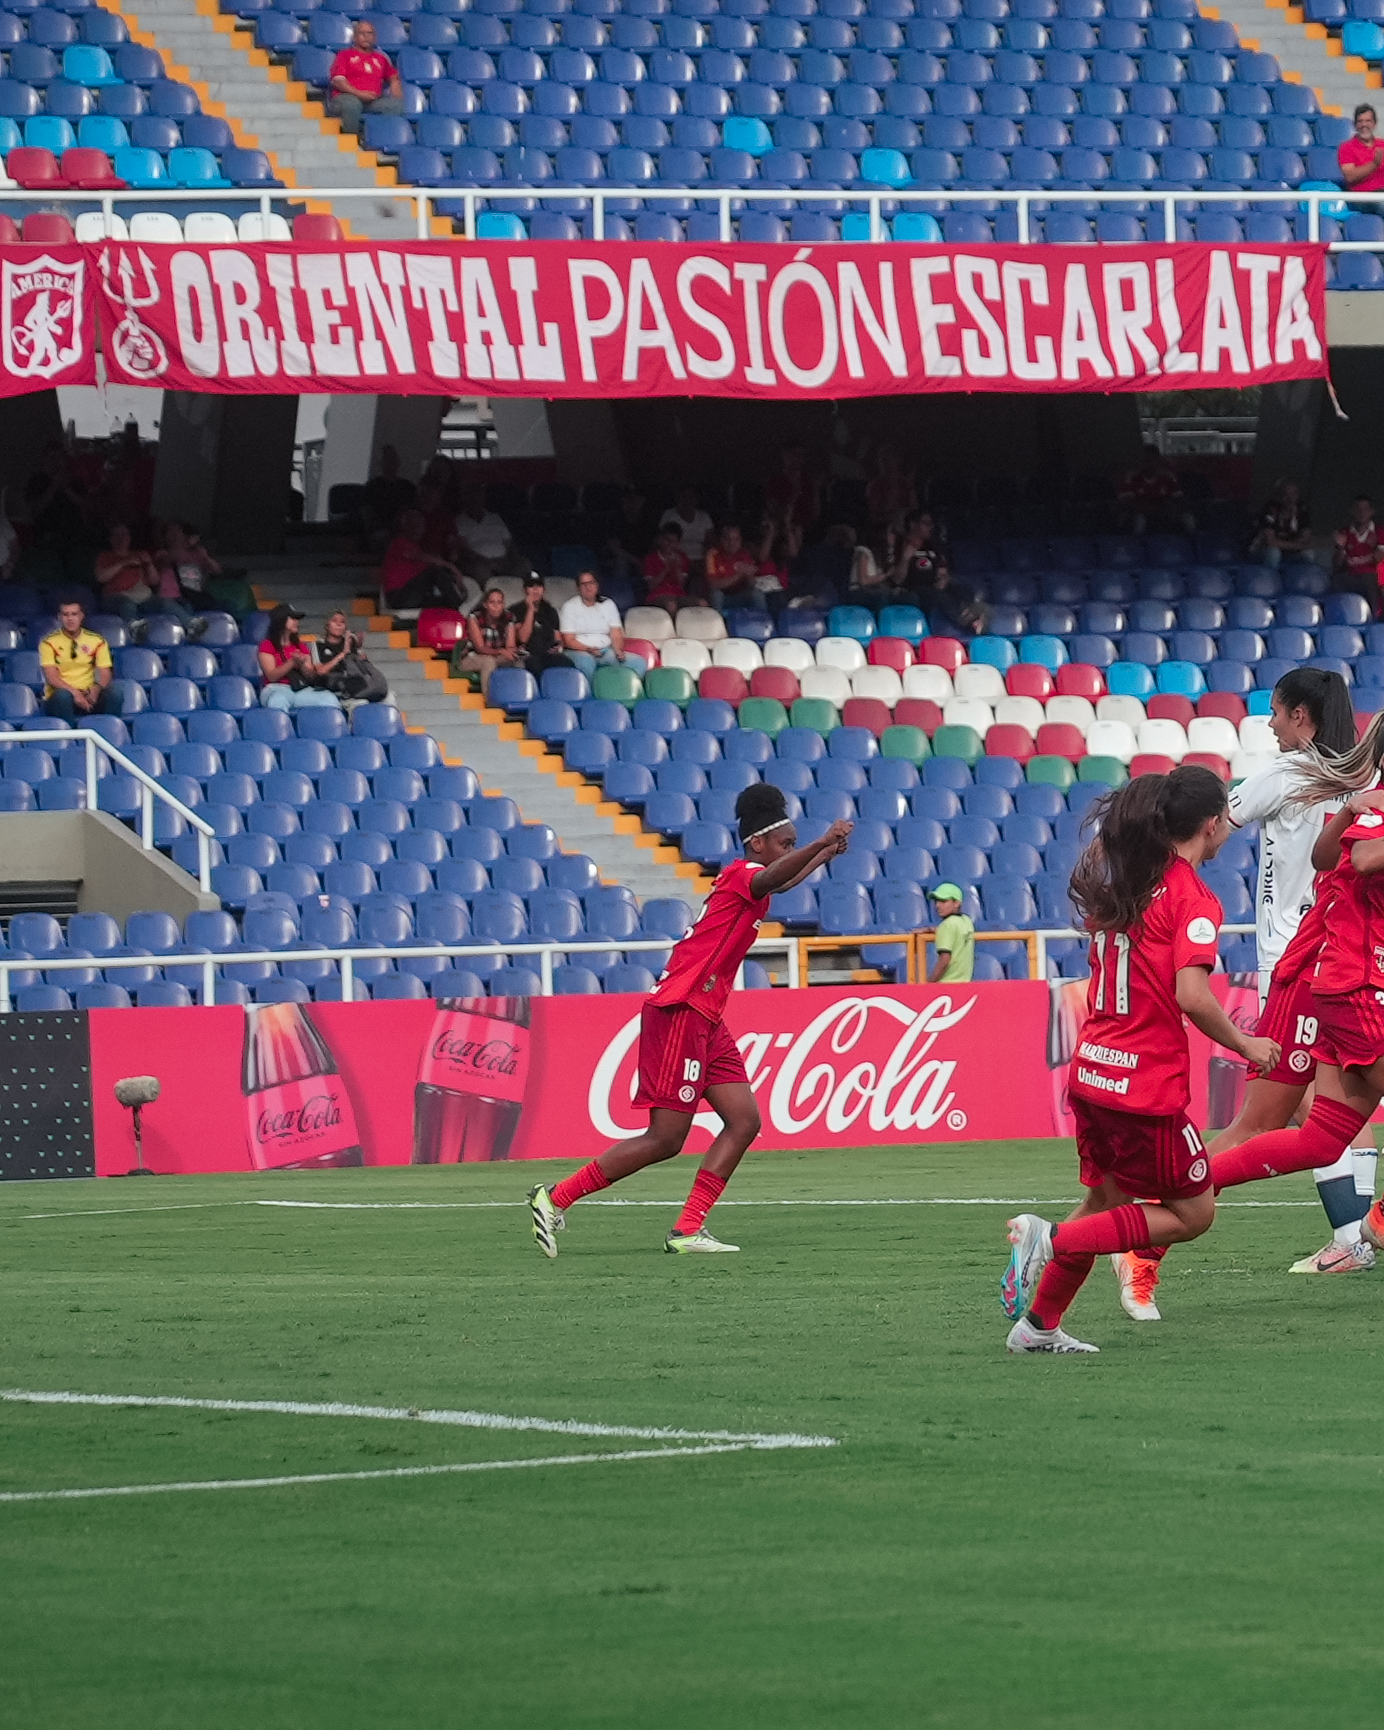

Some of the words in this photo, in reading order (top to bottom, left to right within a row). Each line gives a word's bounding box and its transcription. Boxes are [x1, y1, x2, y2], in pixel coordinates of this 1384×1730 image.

[168, 249, 566, 382] ORIENTAL
[568, 246, 908, 388] PASIÓN
[908, 249, 1323, 380] ESCARLATA
[1094, 930, 1130, 1014] 11
[1294, 1014, 1319, 1046] 19
[432, 1030, 520, 1075] Coca-Cola
[683, 1057, 702, 1083] 18
[1077, 1066, 1131, 1095] Unimed
[256, 1093, 344, 1145] Coca-Cola
[1181, 1122, 1204, 1157] 11
